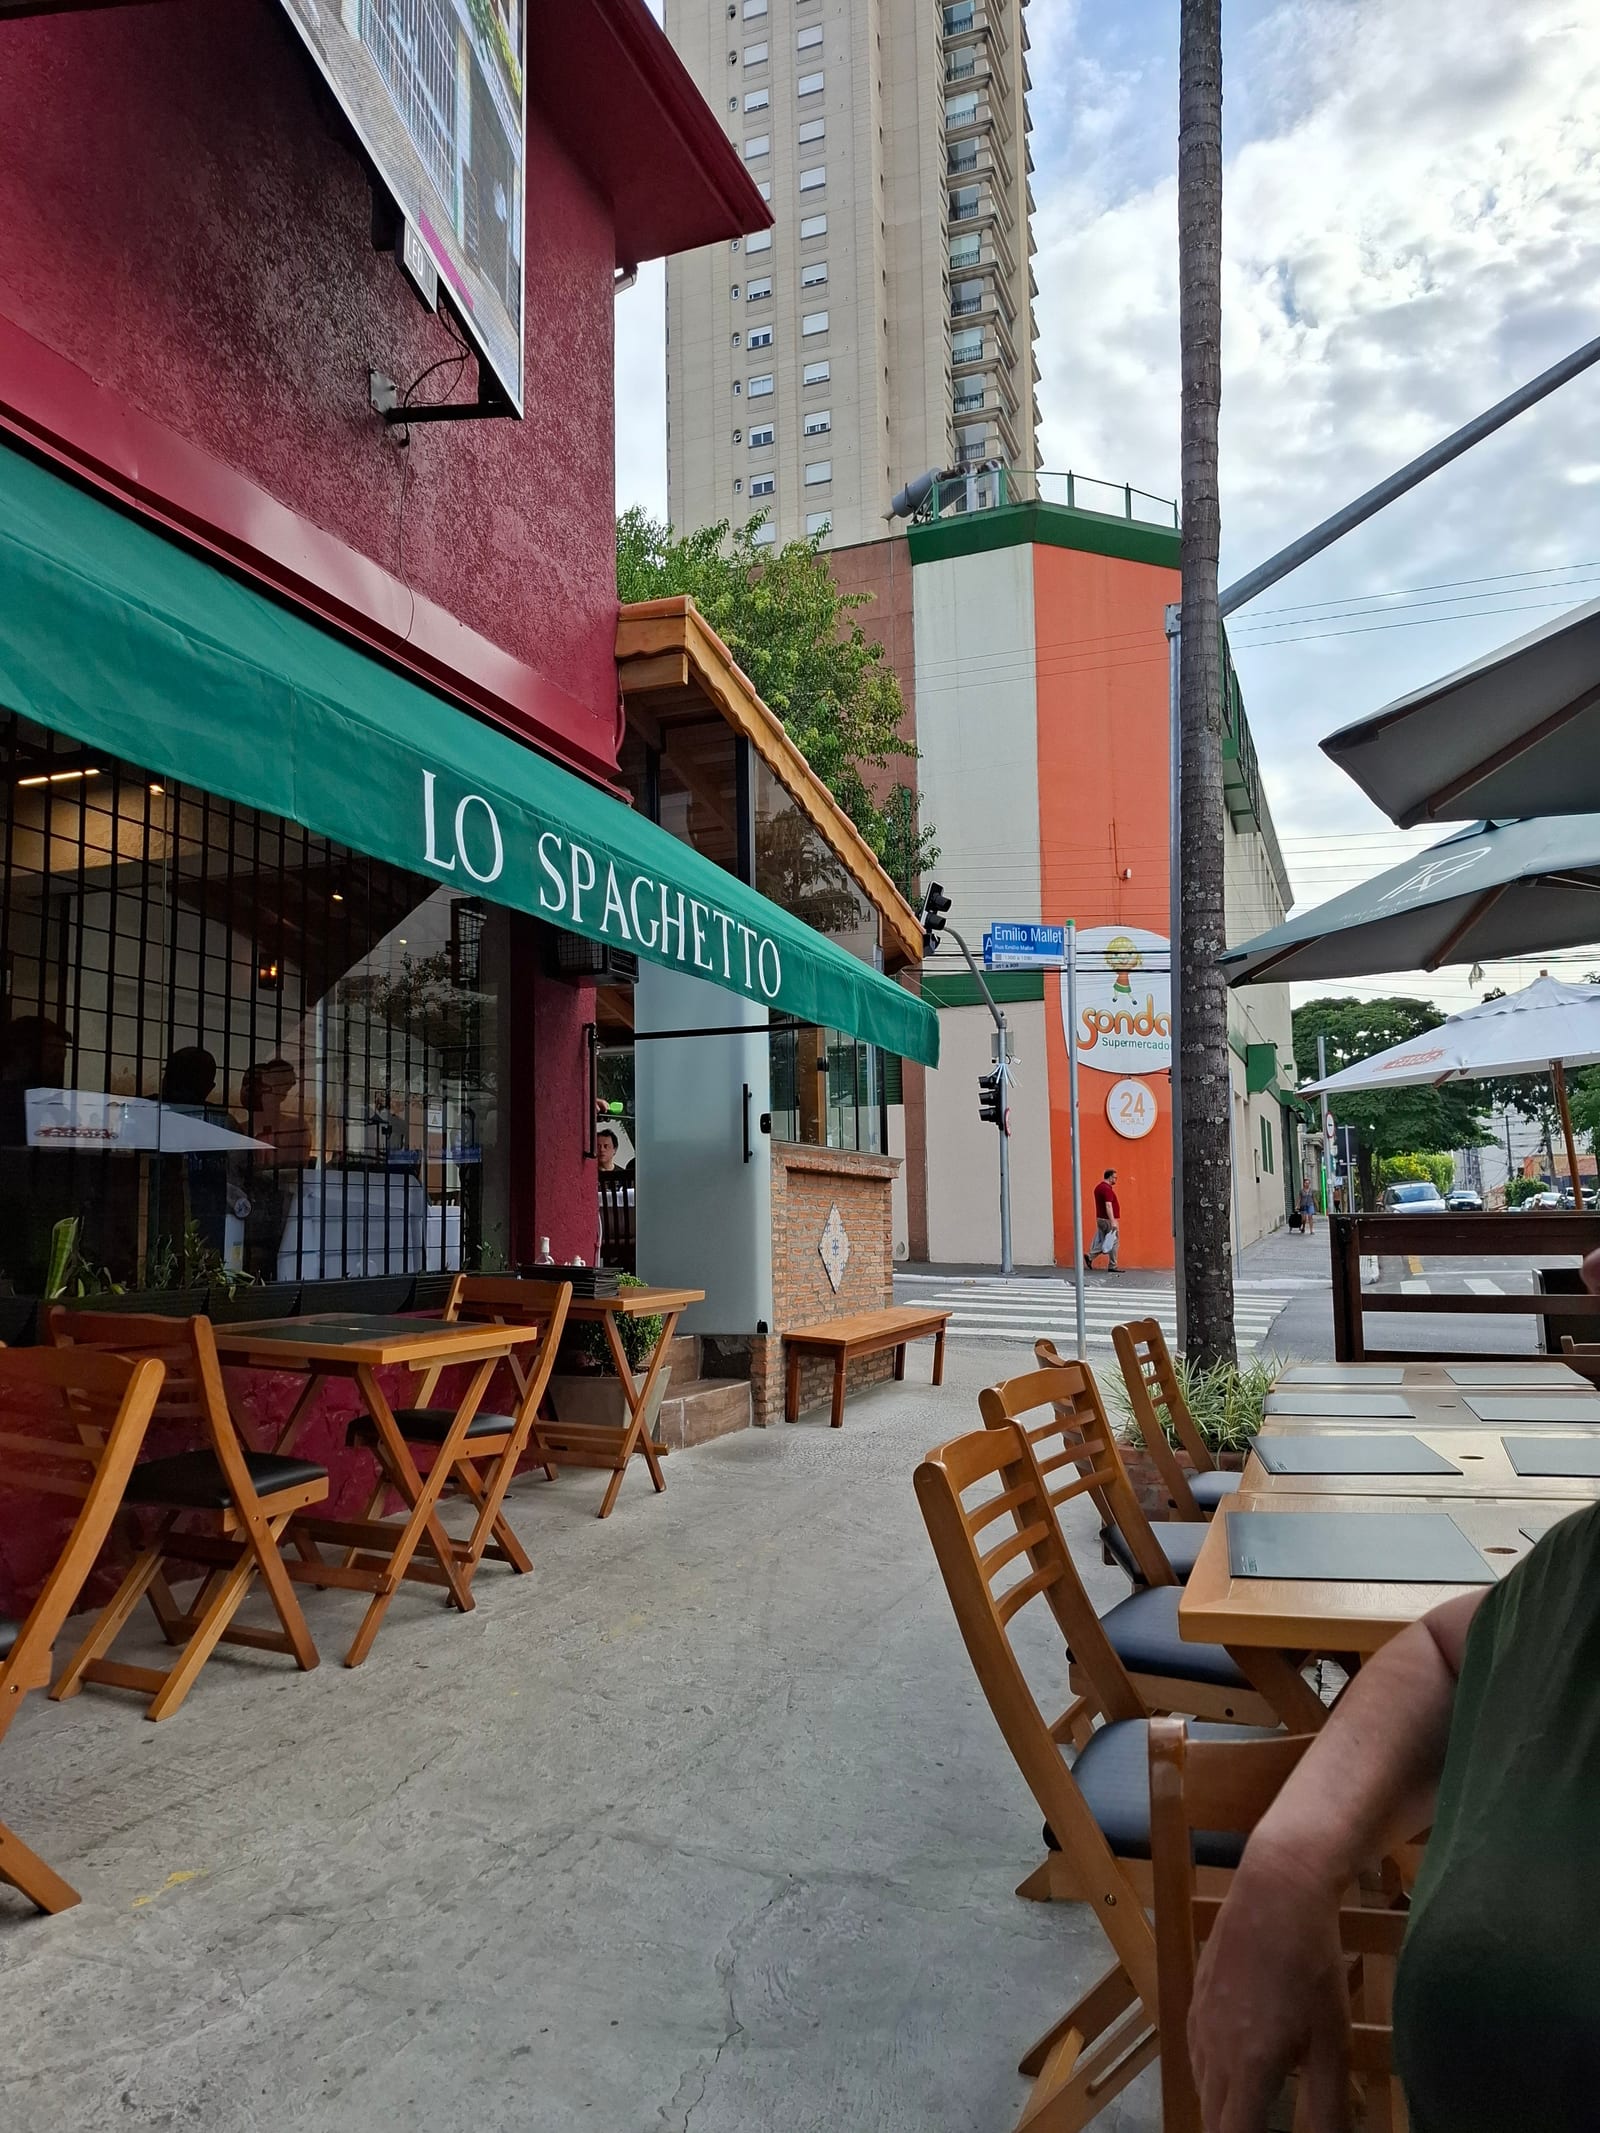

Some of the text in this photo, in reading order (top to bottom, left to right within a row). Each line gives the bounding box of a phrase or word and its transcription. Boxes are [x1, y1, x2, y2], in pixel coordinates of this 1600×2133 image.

[421, 768, 783, 998] LO SPAGHETTO
[1030, 927, 1063, 944] Mallet
[1101, 1036, 1170, 1050] Supermercado
[1120, 1091, 1146, 1118] 24
